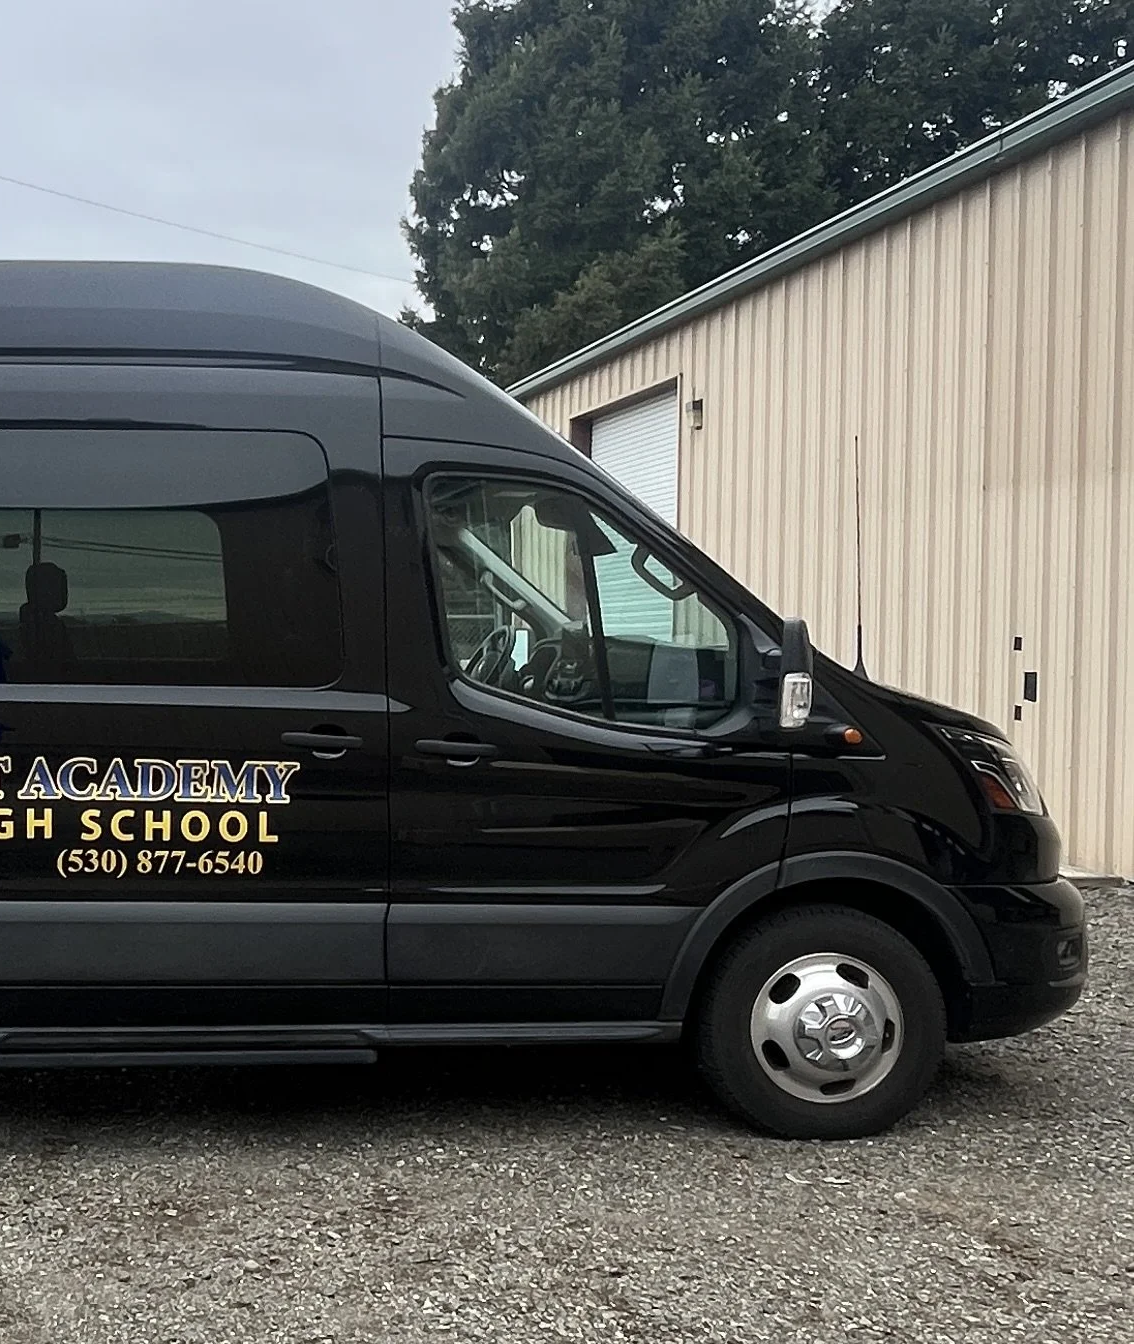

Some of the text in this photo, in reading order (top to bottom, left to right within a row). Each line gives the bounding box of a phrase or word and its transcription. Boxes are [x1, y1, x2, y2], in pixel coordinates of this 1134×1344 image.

[17, 756, 300, 803] ACADEMY
[80, 809, 279, 842] SCHOOL
[56, 849, 264, 878] (530) 877-6540
